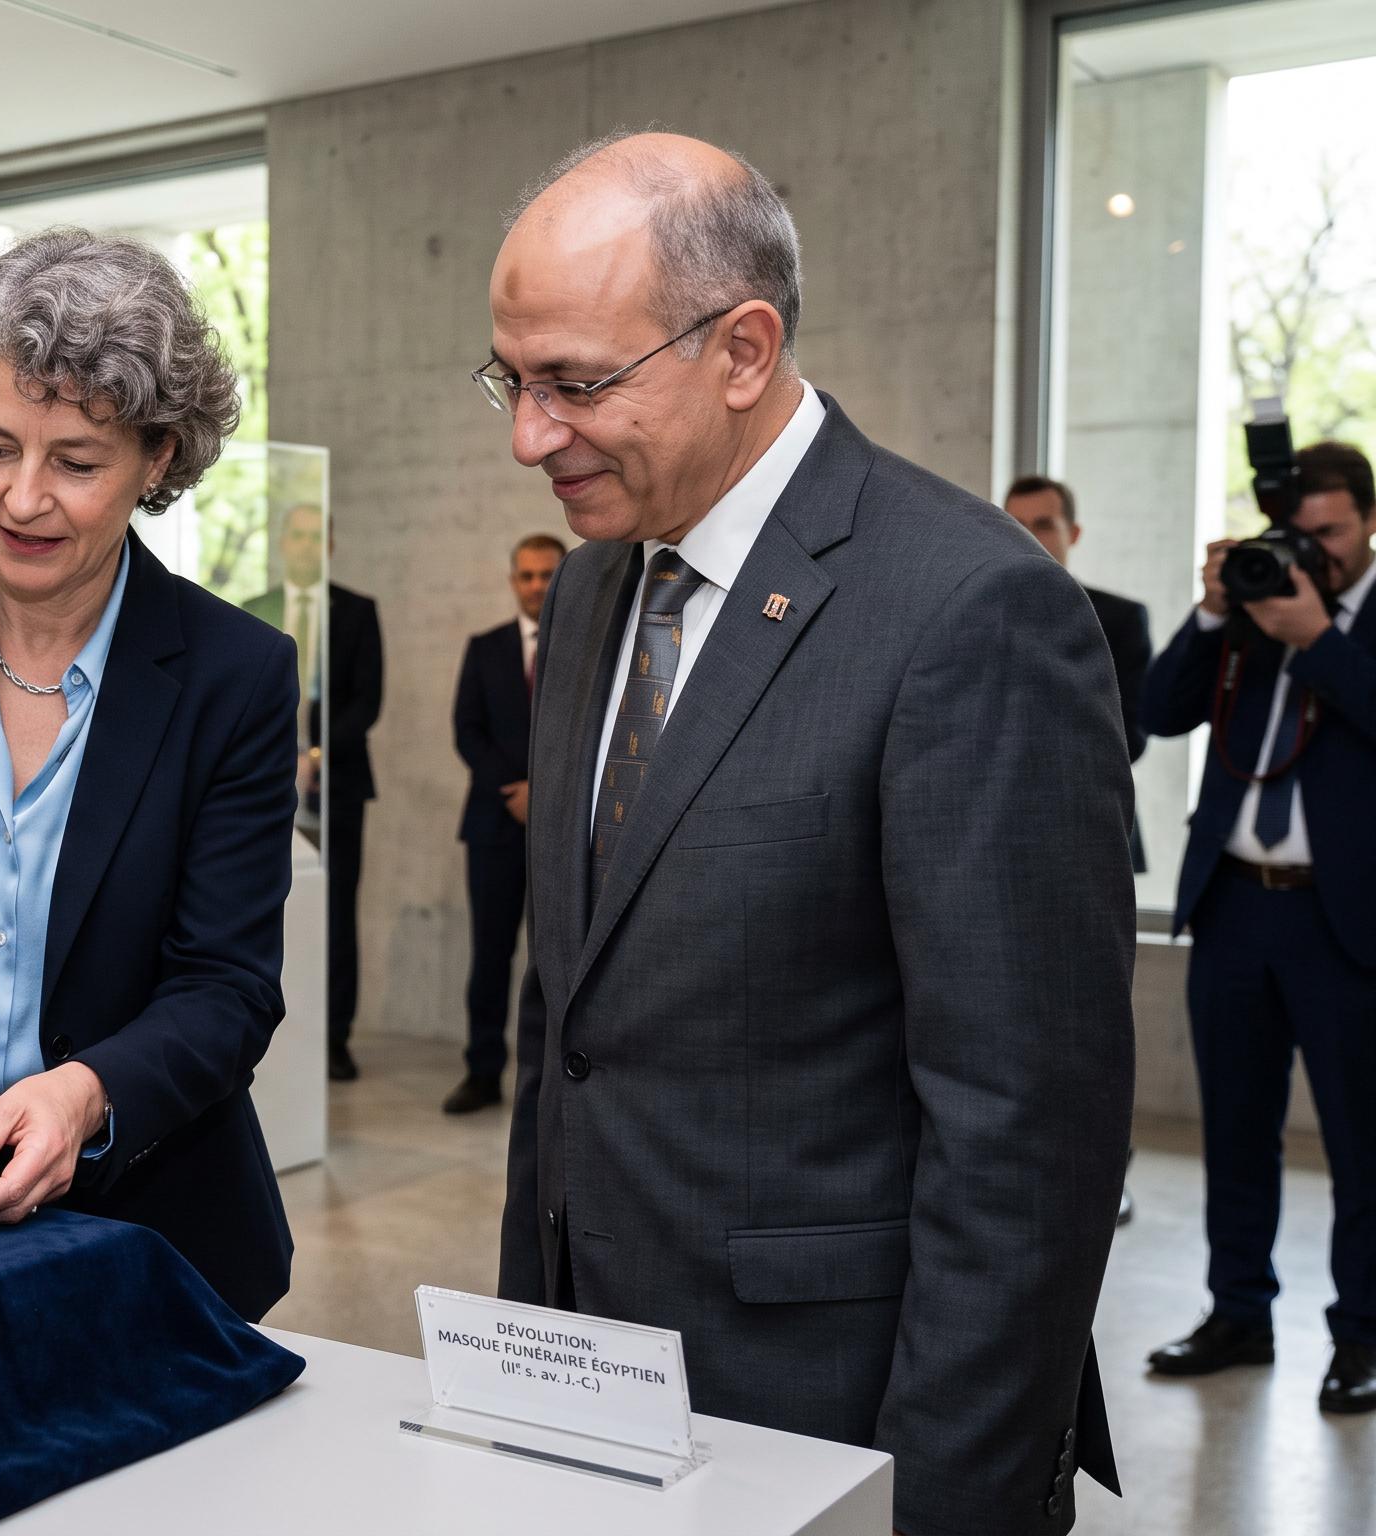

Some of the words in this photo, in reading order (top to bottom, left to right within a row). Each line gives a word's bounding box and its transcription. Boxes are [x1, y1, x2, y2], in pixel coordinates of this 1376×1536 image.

[496, 1322, 597, 1352] DÉVOLUTION:
[438, 1329, 500, 1352] MASQUE
[504, 1342, 588, 1369] FUNÉRAIRE
[591, 1357, 666, 1385] ÉGYPTIEN
[525, 1367, 536, 1378] s.
[541, 1371, 561, 1383] av.
[564, 1373, 601, 1393] J.-C.)
